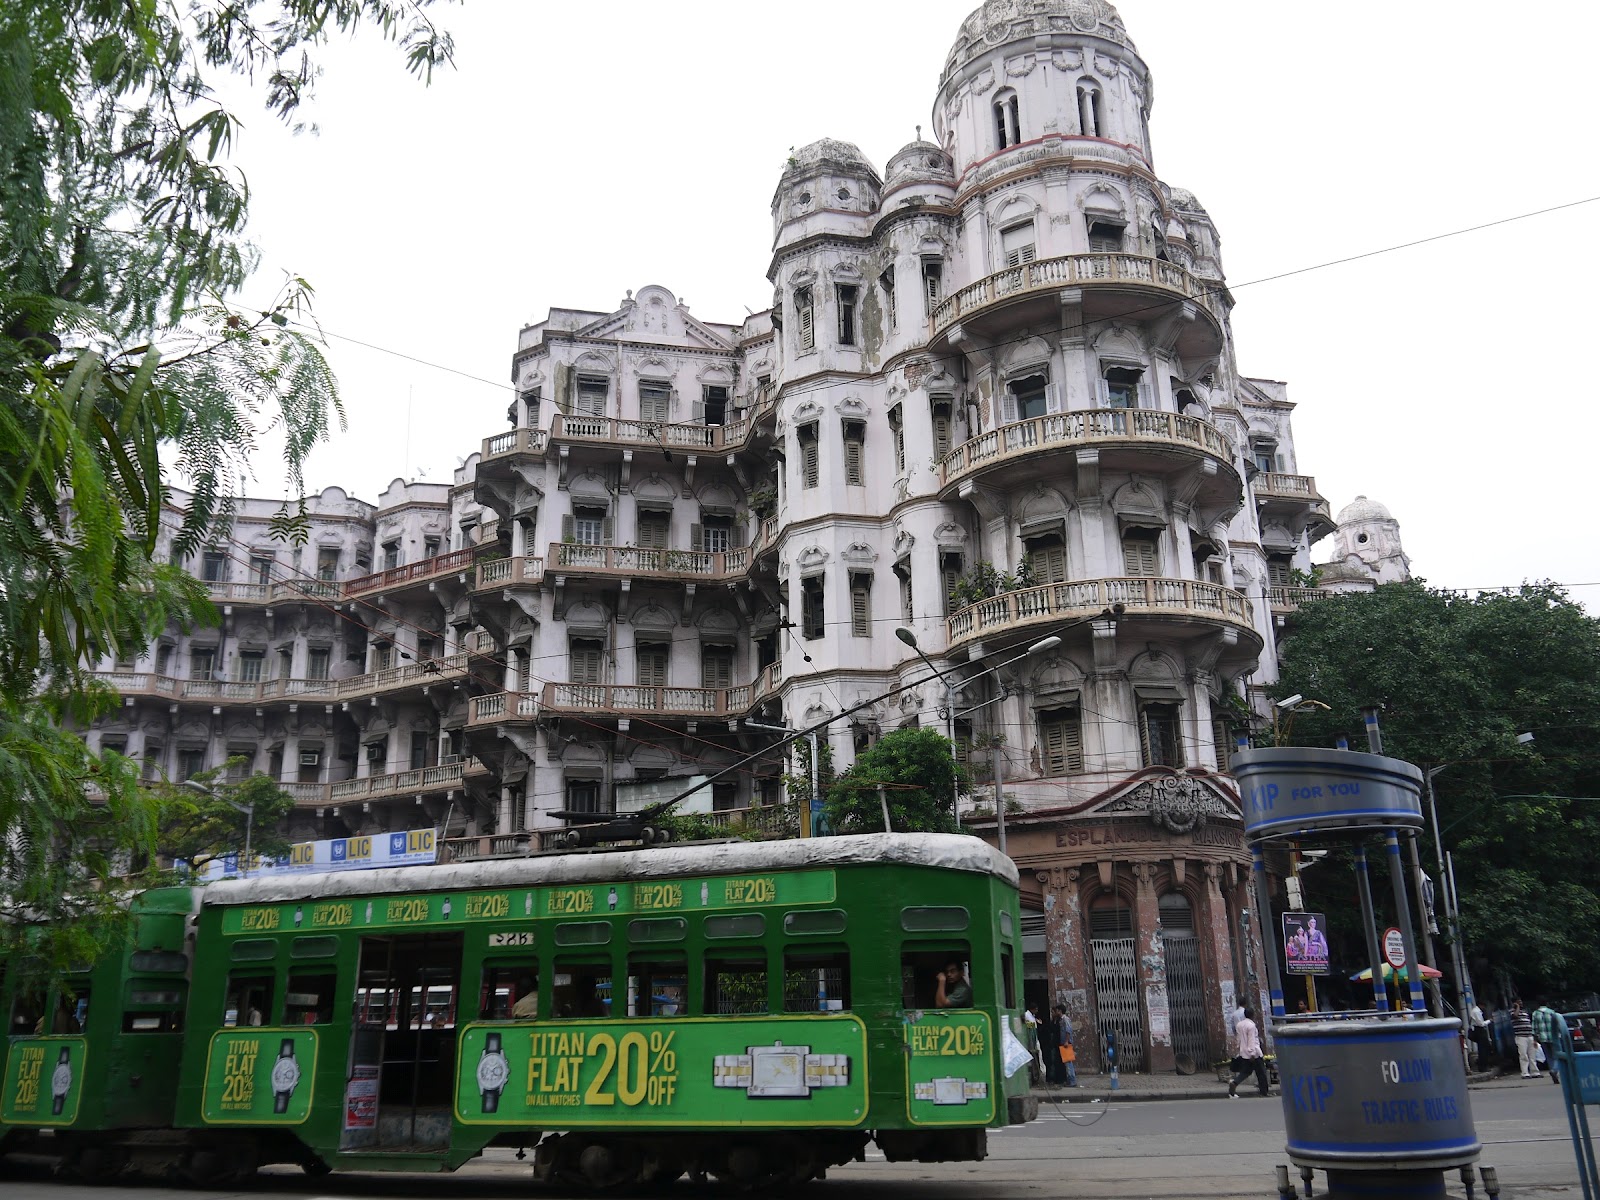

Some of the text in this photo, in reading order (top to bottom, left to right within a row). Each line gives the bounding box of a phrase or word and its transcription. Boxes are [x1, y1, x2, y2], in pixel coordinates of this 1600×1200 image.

[1291, 785, 1323, 801] FOR
[1328, 782, 1361, 797] YOU
[409, 832, 432, 851] LIC
[1055, 826, 1243, 849] ESPLANADE MANSIONS
[292, 845, 312, 863] LIC
[349, 838, 370, 857] LIC
[635, 886, 653, 894] TITAN
[725, 880, 745, 888] TITAN
[634, 894, 653, 905] FLAT
[725, 888, 744, 899] FLAT
[465, 903, 482, 914] FLAT
[548, 899, 565, 910] FLAT
[312, 911, 327, 923] FLAT
[387, 907, 402, 919] FLAT
[242, 916, 257, 926] FLAT
[912, 1026, 939, 1035] TITAN
[228, 1040, 259, 1054] TITAN
[530, 1032, 585, 1056] TITAN
[912, 1025, 983, 1056] FLAT 20%
[22, 1047, 45, 1060] TITAN
[970, 1043, 984, 1055] OFF
[18, 1061, 42, 1080] FLAT
[527, 1031, 676, 1106] FLAT 20%
[1381, 1058, 1433, 1084] FOLLOW
[222, 1054, 257, 1102] FLAT 20%
[648, 1076, 676, 1106] OFF
[526, 1094, 581, 1106] ON ALL WATCHES
[1362, 1095, 1458, 1125] TRAFFIC RULES
